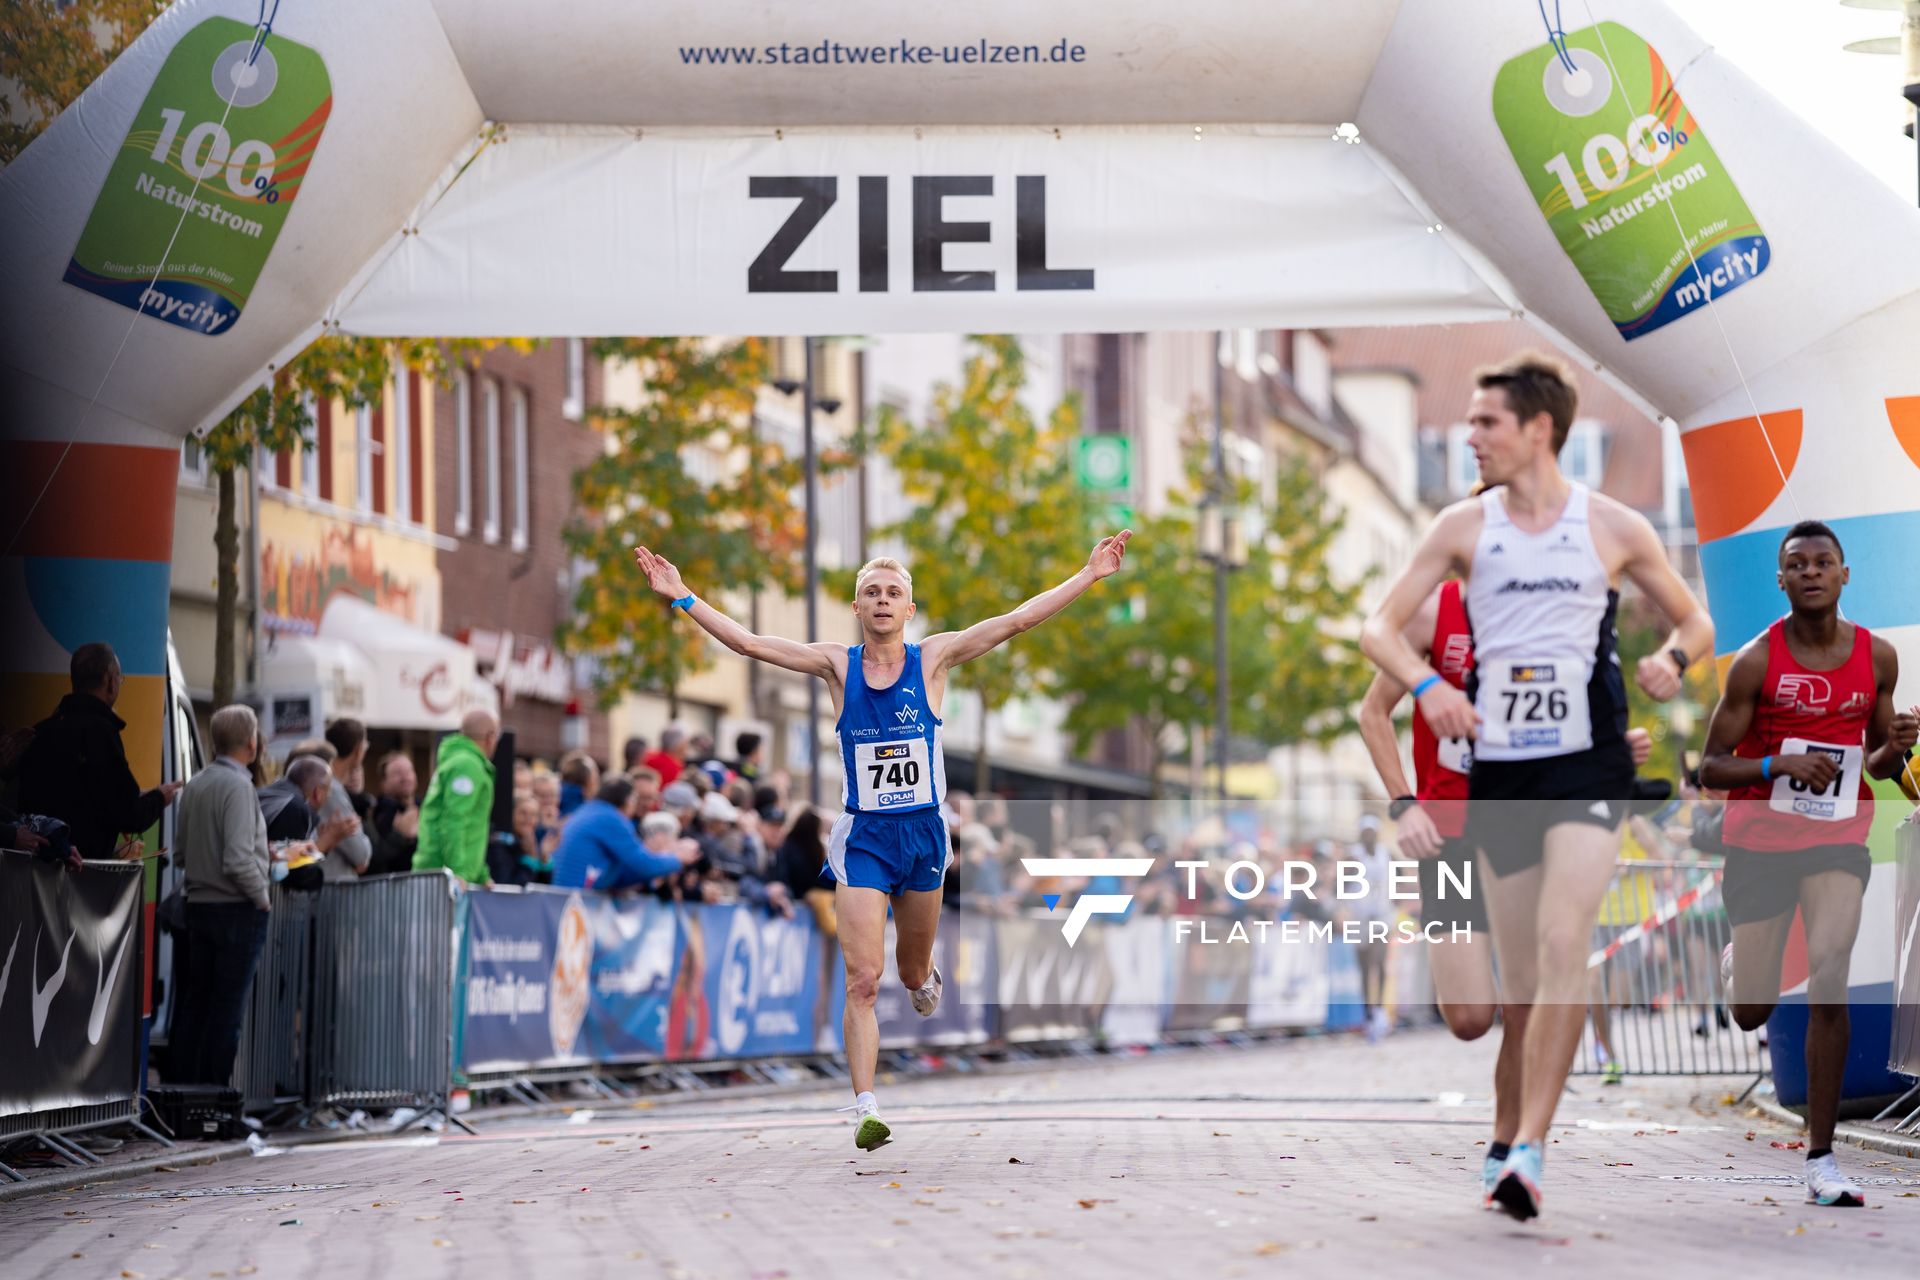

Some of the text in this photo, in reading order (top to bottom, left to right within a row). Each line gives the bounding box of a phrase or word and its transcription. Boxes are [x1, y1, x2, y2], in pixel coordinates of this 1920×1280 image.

[679, 38, 1087, 65] www.stadtwerke-uelzen.de
[150, 107, 279, 204] 100%
[135, 172, 264, 238] Naturstrom
[1578, 162, 1708, 240] Naturstrom
[747, 175, 1096, 293] ZIEL
[1699, 218, 1728, 239] Natur
[102, 260, 235, 285] Reiner Strom aus der Natur
[1501, 689, 1568, 723] 726
[850, 728, 880, 737] VIACTIV
[893, 747, 908, 757] GLS
[867, 760, 920, 790] 740
[893, 792, 914, 801] PLAN
